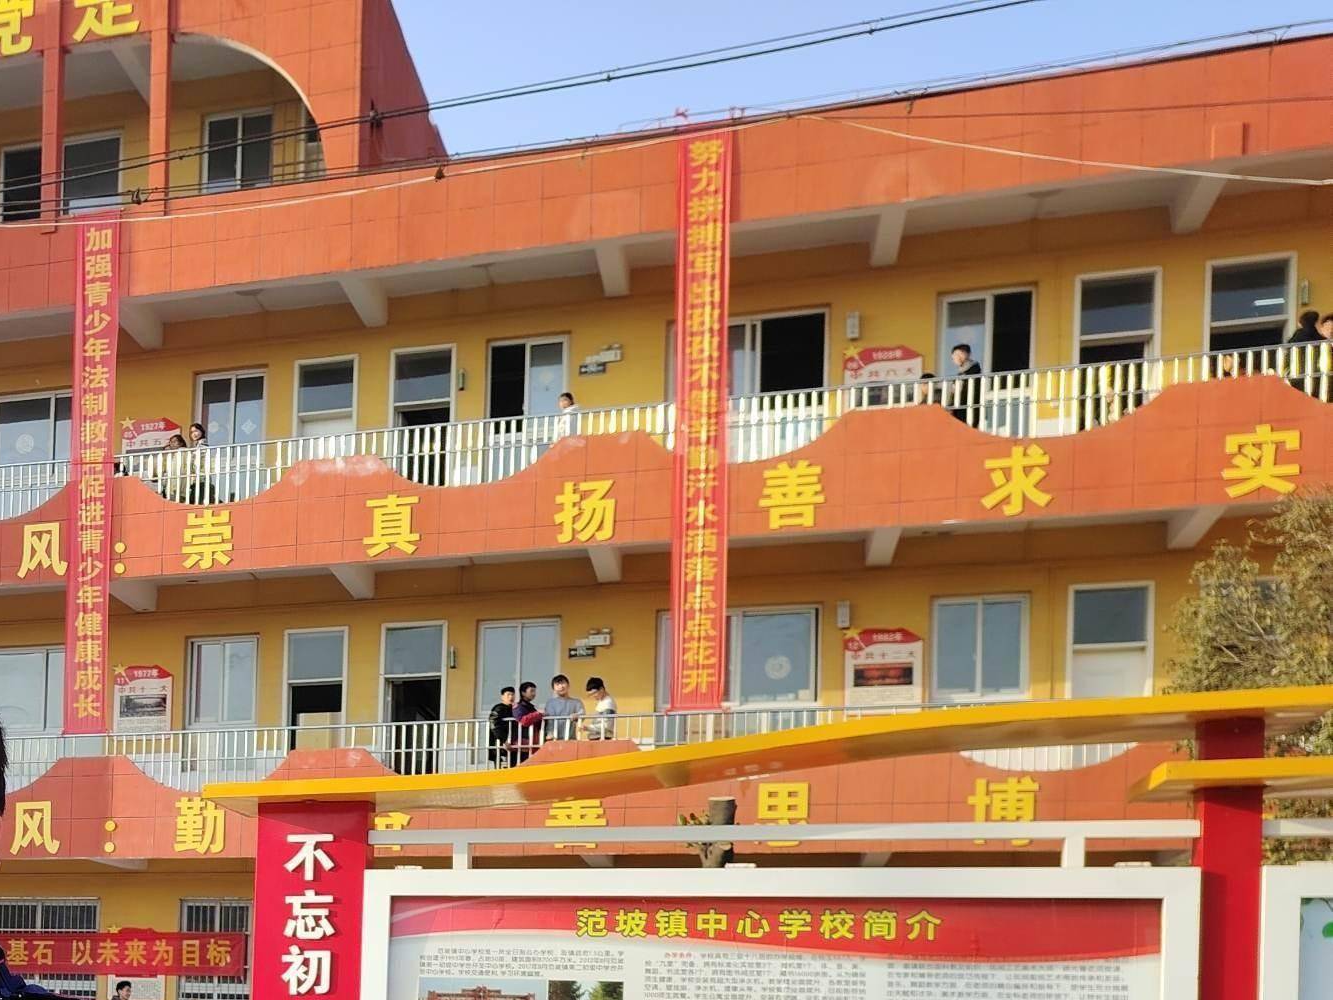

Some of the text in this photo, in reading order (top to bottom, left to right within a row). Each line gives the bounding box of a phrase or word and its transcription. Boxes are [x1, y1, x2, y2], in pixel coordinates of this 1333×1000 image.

[73, 227, 113, 718] 加强青少年法制教育促进青少年健康成长
[575, 908, 942, 941] 范坡镇中心学校简介
[6, 938, 233, 967] 基石 以未来为目标
